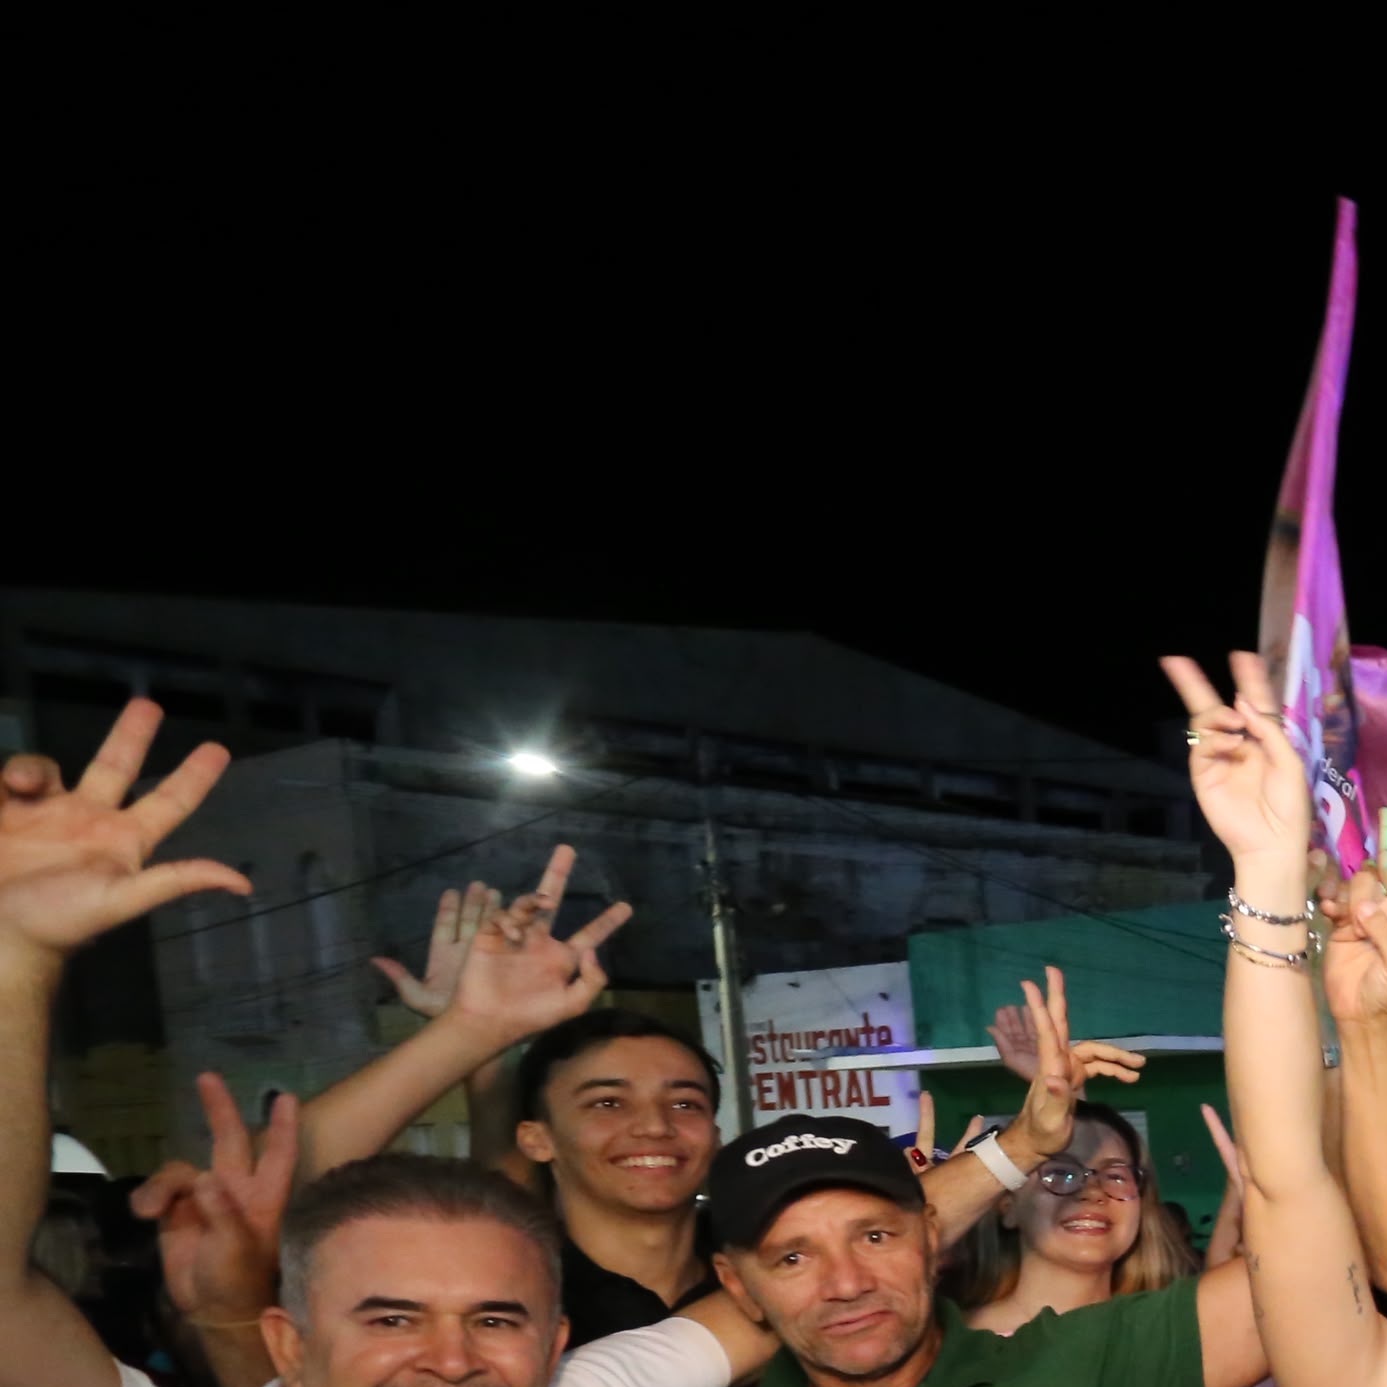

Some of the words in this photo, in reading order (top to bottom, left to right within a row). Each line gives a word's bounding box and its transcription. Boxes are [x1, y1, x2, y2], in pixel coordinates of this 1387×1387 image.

[750, 1012, 893, 1066] staurante
[752, 1070, 890, 1111] ENTRAL
[745, 1133, 858, 1167] Coffey
